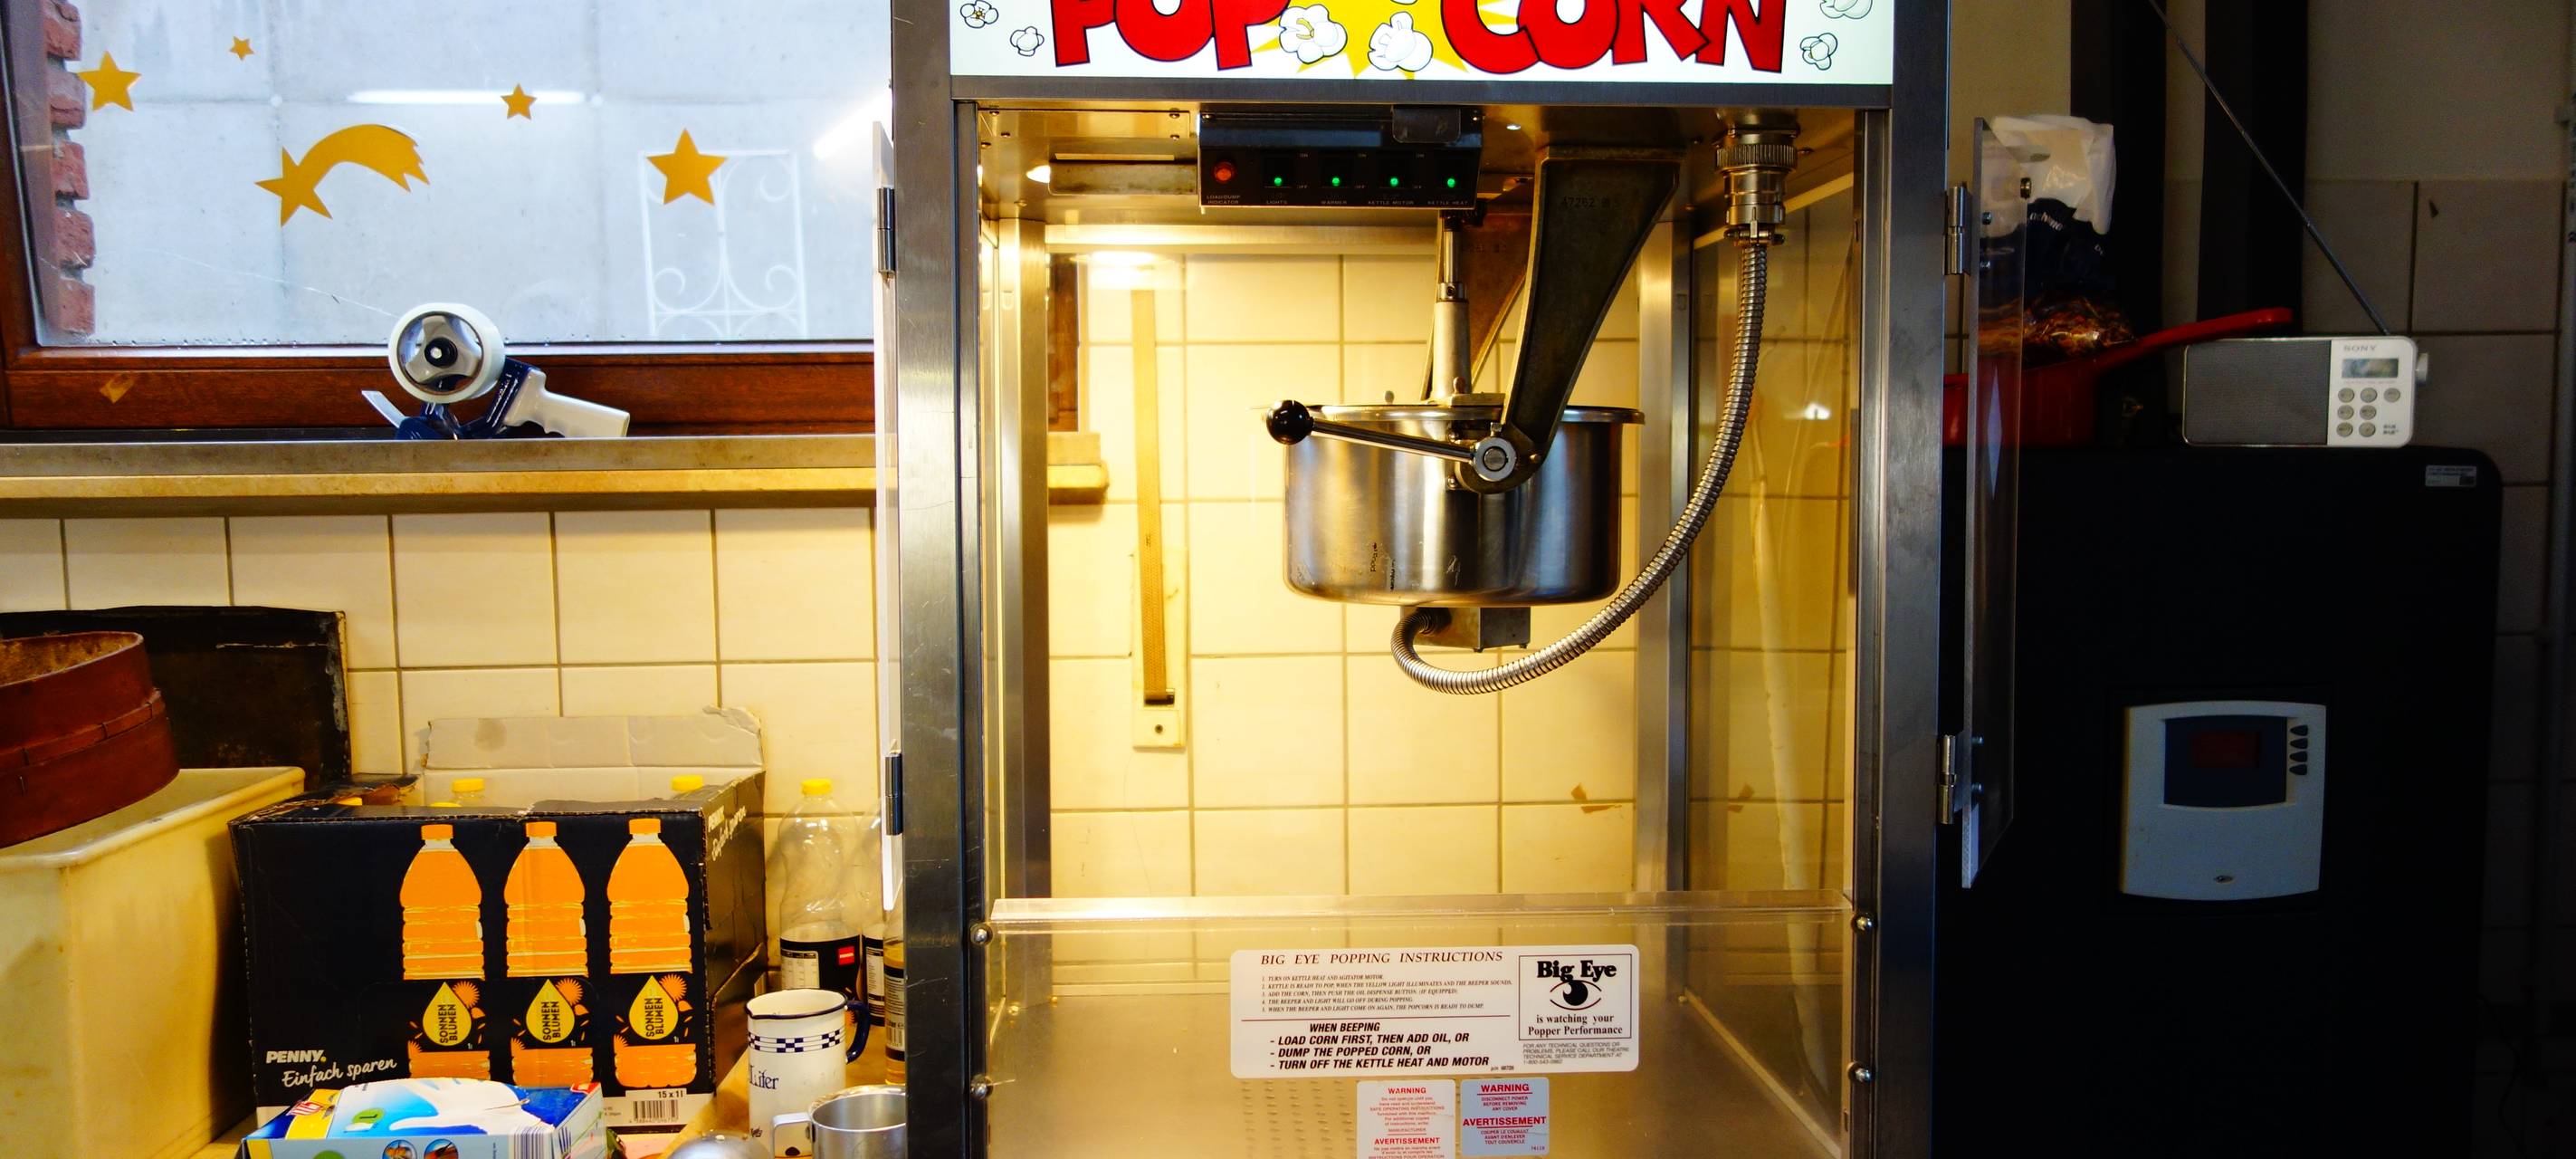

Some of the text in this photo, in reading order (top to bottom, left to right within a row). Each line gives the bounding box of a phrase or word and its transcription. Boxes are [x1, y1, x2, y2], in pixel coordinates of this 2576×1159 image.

[1261, 952, 1503, 965] BIG EYE POPPING INSTRUCTIONS
[1537, 960, 1617, 983] Big Eye
[448, 1003, 458, 1041] BLUMEN
[541, 1001, 551, 1040] SONNEN
[551, 1001, 561, 1039] BLUMEN
[644, 998, 654, 1038] SONNEN
[654, 997, 664, 1035] BLUMEN
[1536, 1014, 1614, 1025] is watching your
[438, 1004, 448, 1044] SONNEN
[1310, 1022, 1380, 1032] WHEN BEEPING
[1528, 1026, 1623, 1038] Popper Performance
[1278, 1033, 1470, 1045] LOAD CORN FIRST, THEN ADD OIL, OR
[1278, 1046, 1432, 1058] DUMP THE POPPED CORN, OR
[1279, 1057, 1489, 1069] TURN OFF THE KETTLE HEAT AND MOTOR
[281, 1058, 397, 1087] Einfach sparen
[1481, 1083, 1530, 1092] WARNING
[1463, 1116, 1547, 1126] AVERTISSEMENT
